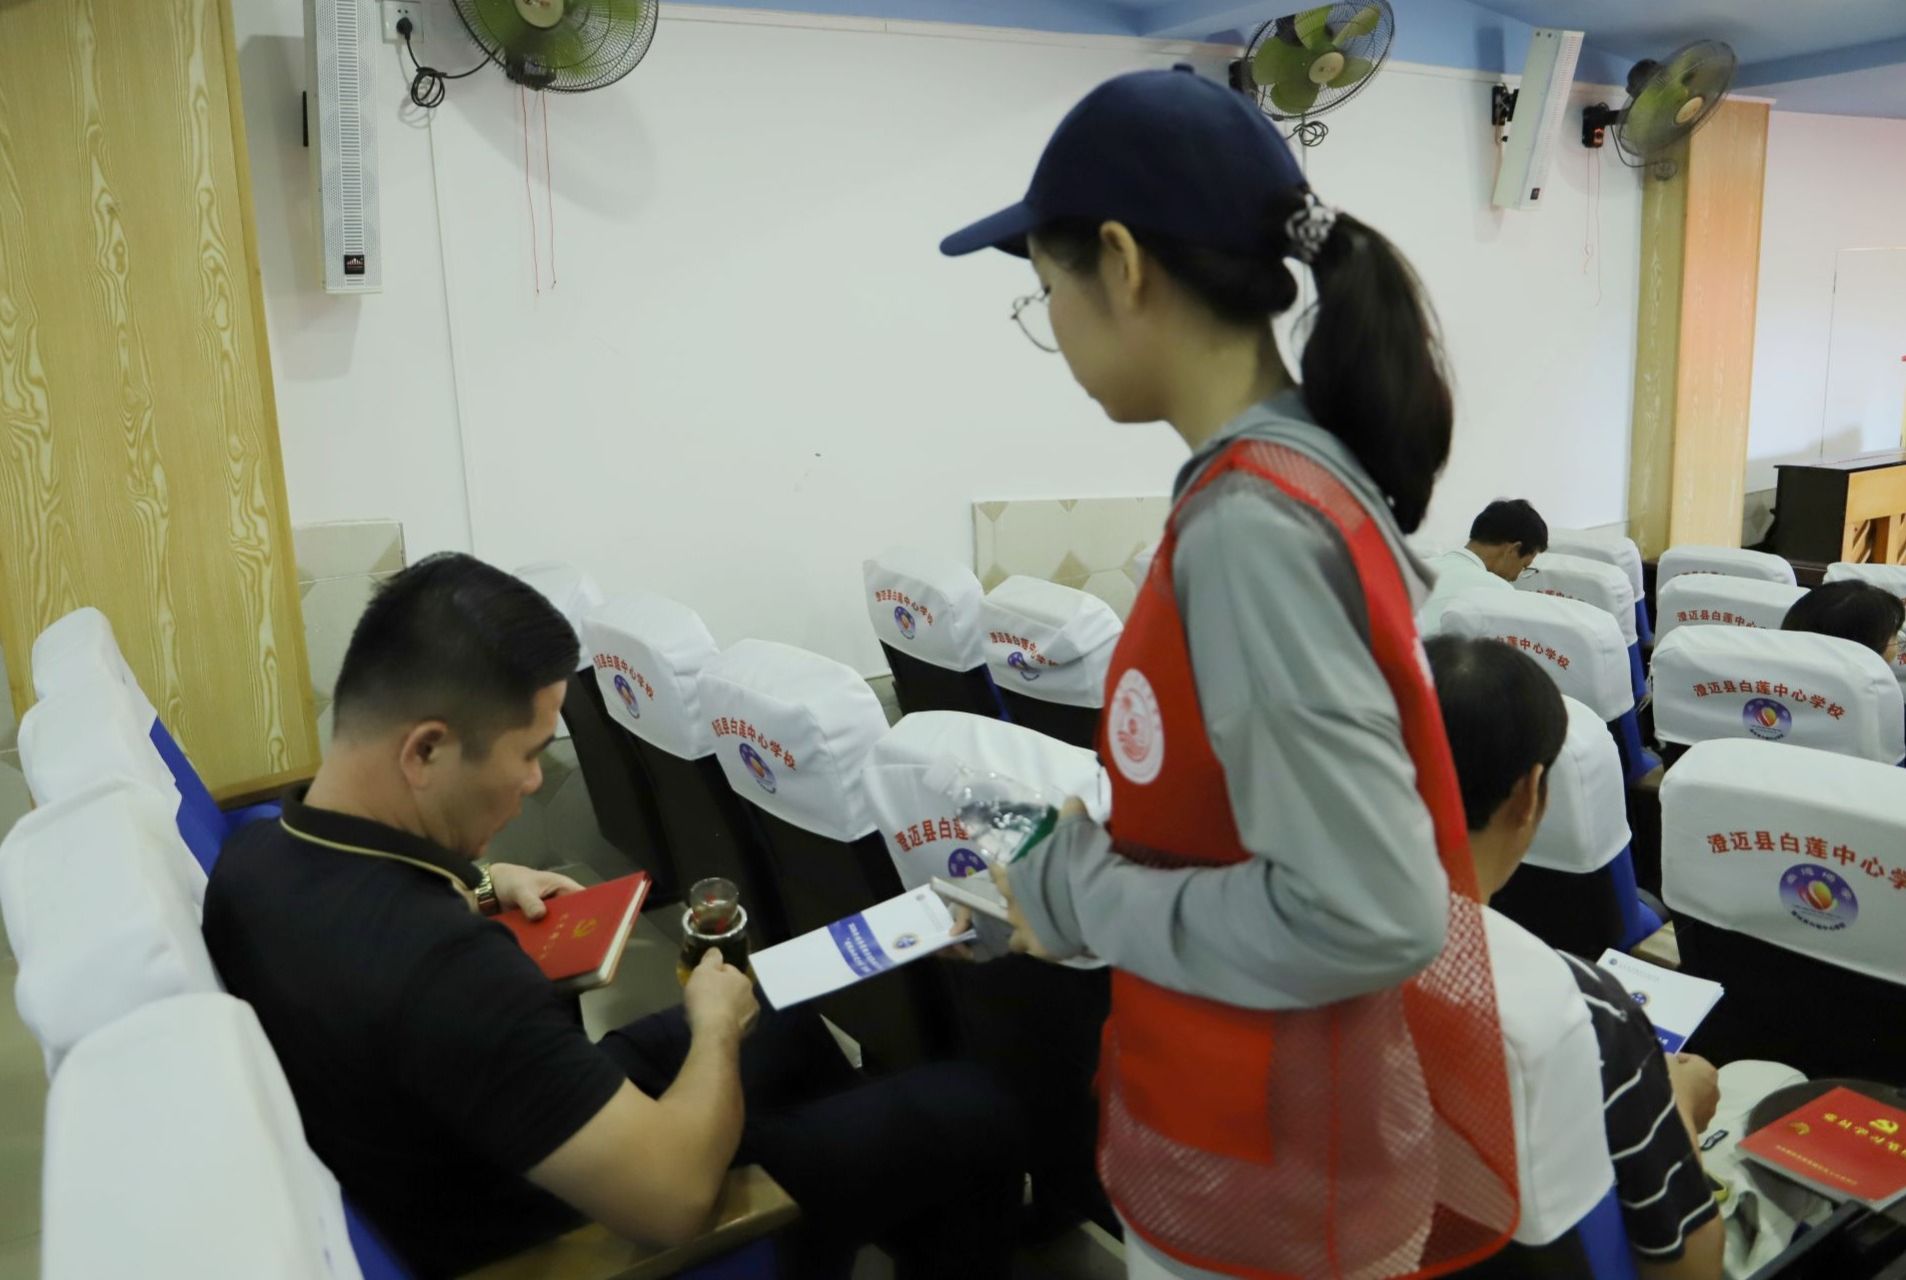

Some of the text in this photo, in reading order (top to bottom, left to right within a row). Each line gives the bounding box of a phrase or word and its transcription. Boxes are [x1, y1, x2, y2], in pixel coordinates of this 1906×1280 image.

[1693, 680, 1845, 720] 澄迈县白莲中心学校
